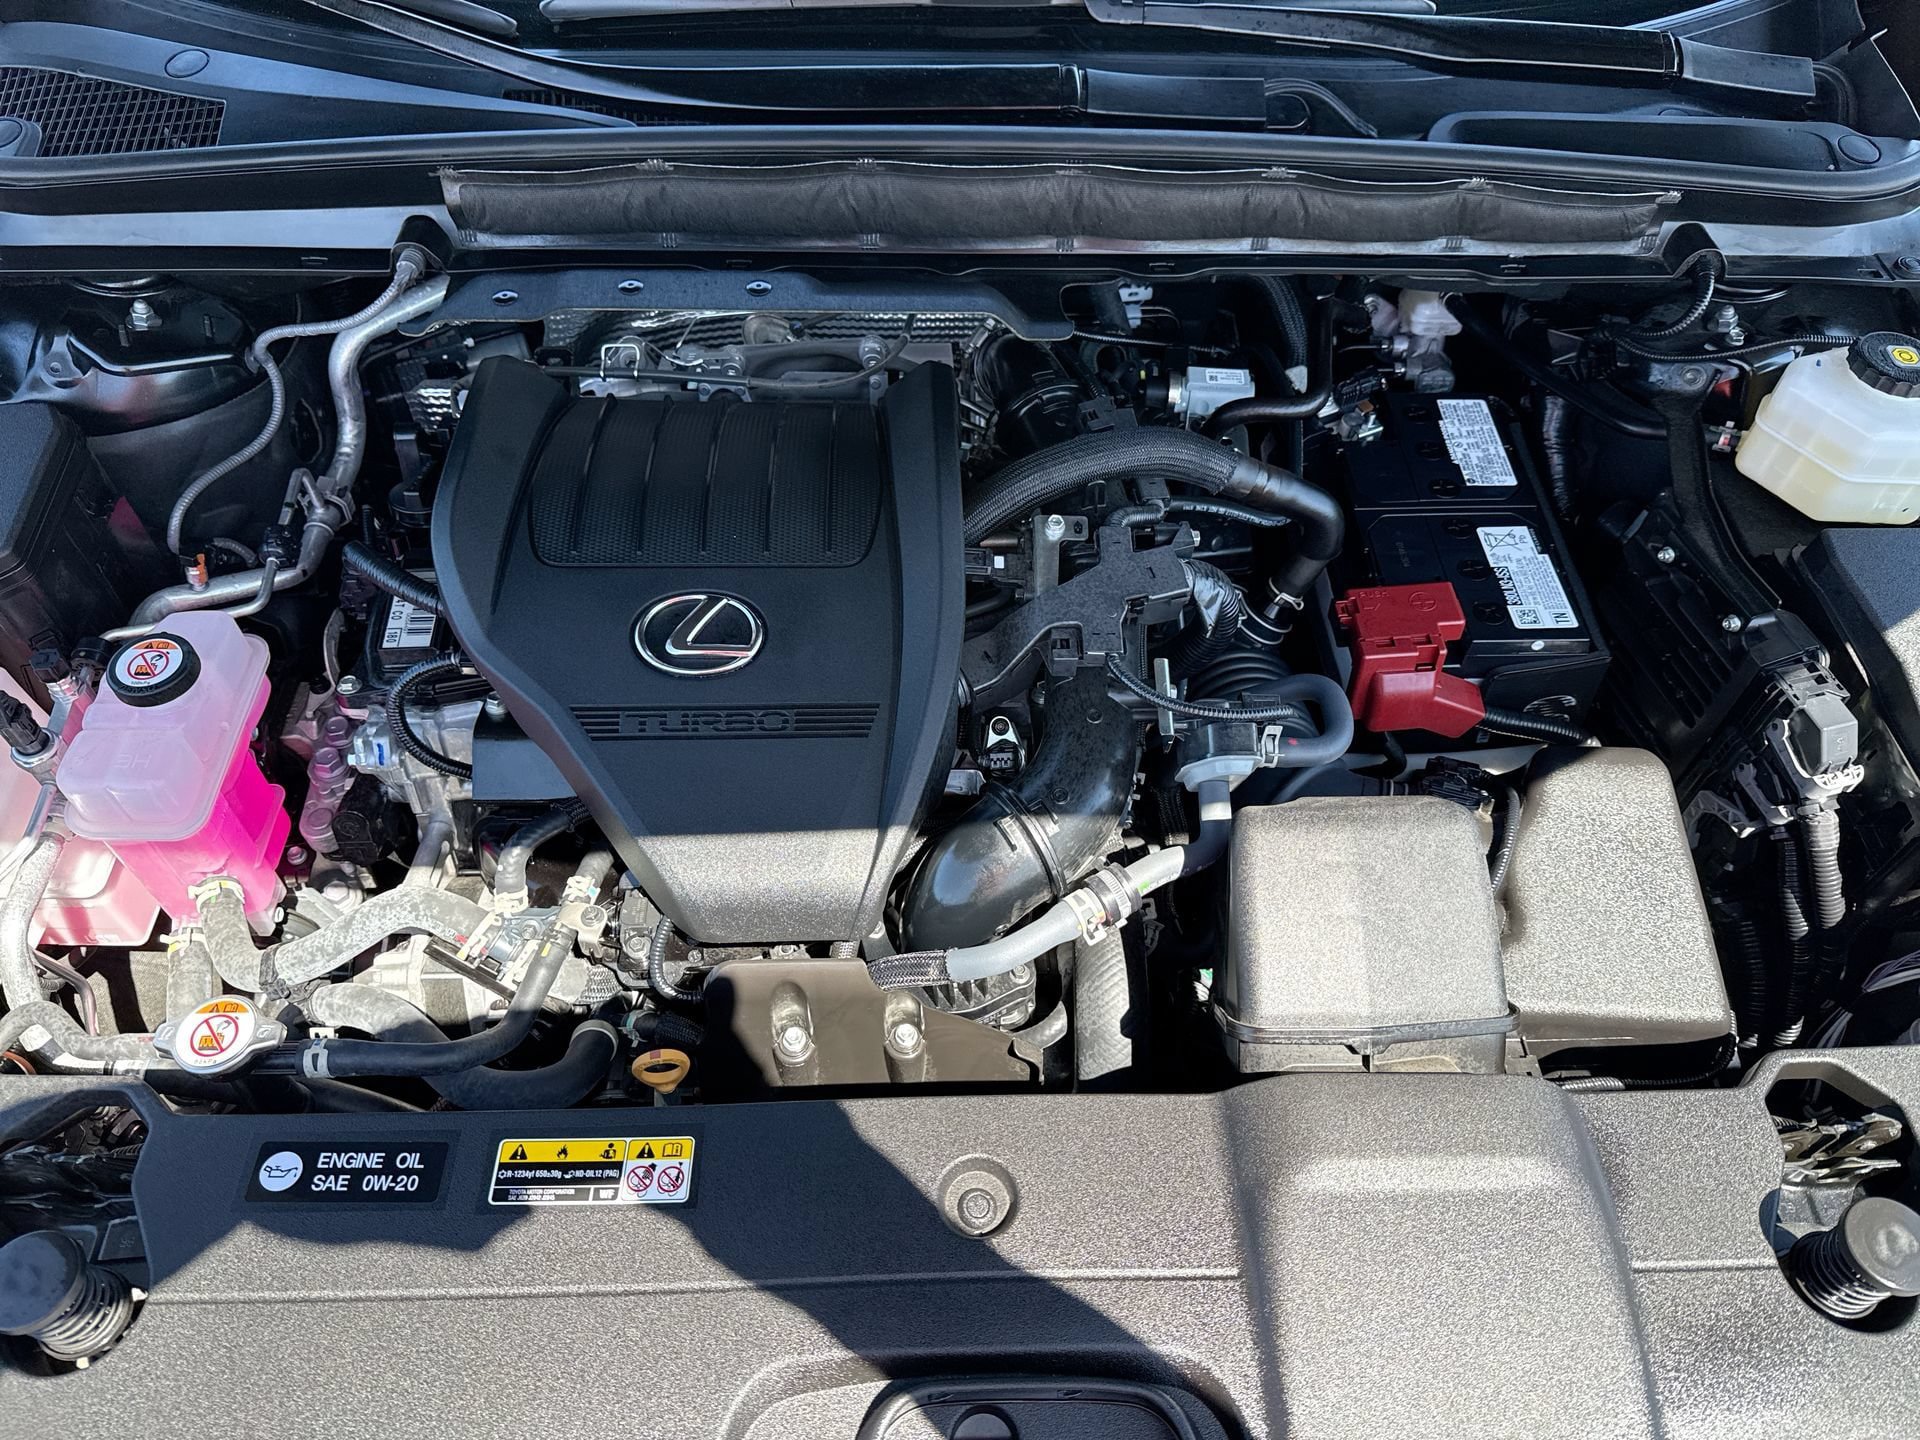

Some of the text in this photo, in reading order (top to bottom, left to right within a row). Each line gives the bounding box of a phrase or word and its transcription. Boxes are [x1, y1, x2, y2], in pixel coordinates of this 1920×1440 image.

[1551, 612, 1571, 625] TN
[386, 631, 398, 643] 180
[624, 709, 792, 733] TURBO
[316, 1152, 425, 1169] ENGINE OIL
[506, 1169, 535, 1179] R-1234yf
[602, 1169, 620, 1179] (PAG)
[311, 1174, 419, 1191] SAE 0W-20
